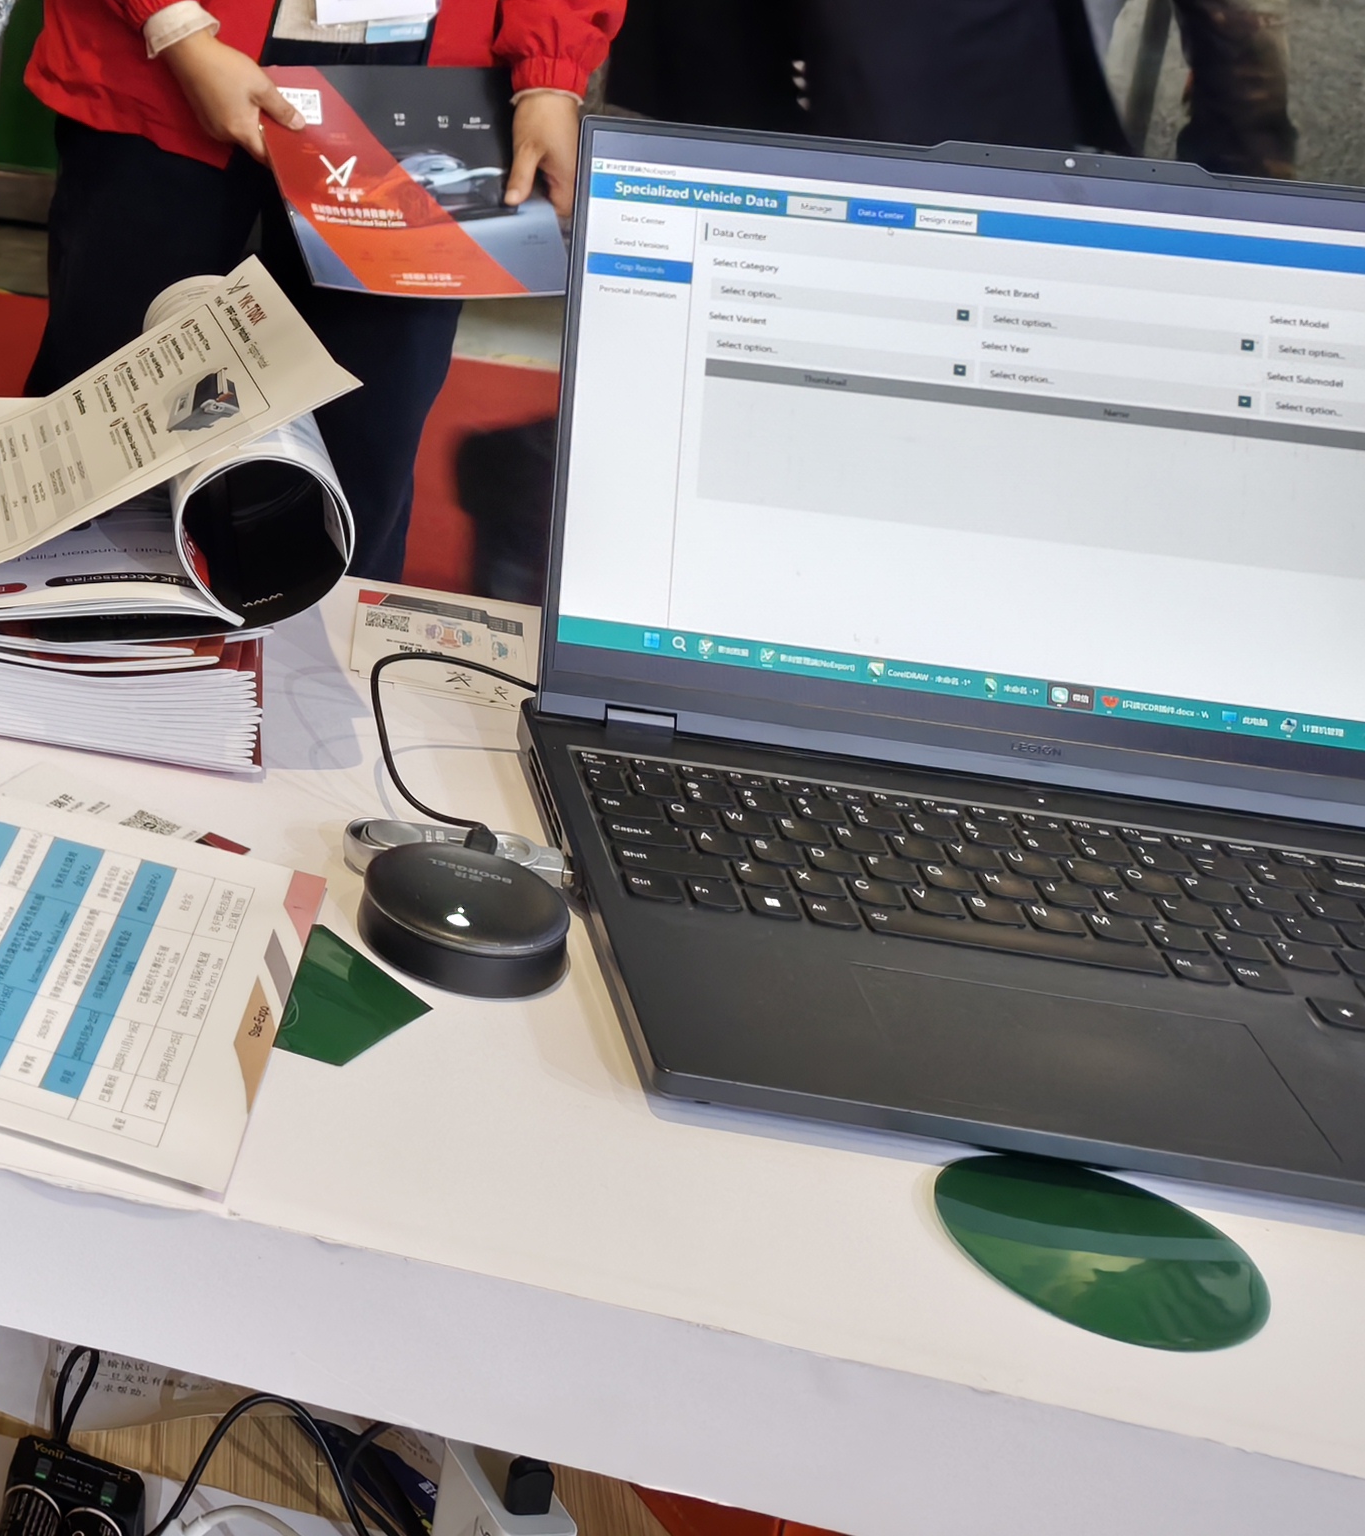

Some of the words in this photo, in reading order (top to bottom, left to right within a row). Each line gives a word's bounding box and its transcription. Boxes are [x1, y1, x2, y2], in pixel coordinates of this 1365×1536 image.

[614, 181, 689, 201] Specialized
[693, 189, 742, 206] Vehicle
[746, 194, 778, 210] Data
[801, 203, 833, 214] Manage
[621, 215, 640, 225] Data
[642, 217, 666, 227] Center
[858, 209, 876, 220] Data
[878, 210, 904, 222] Center
[919, 215, 946, 228] Design
[948, 218, 973, 229] center
[713, 227, 738, 240] Data
[740, 229, 767, 242] Center
[614, 238, 637, 249] Saved
[639, 240, 669, 251] Versions
[614, 263, 633, 275] Crop
[635, 264, 665, 275] Records
[713, 258, 738, 271] Select
[740, 260, 779, 275] Category
[599, 285, 633, 296] Personal
[635, 288, 677, 300] Information
[721, 286, 745, 296] Select
[985, 286, 1011, 298] Select
[1013, 289, 1040, 299] Brand
[709, 312, 734, 323] Select
[736, 314, 767, 325] Variant
[993, 315, 1019, 326] Select
[1269, 315, 1296, 326] Select
[1299, 318, 1330, 329] Model
[716, 340, 741, 350] Select
[981, 341, 1007, 352] Select
[1010, 343, 1030, 354] Year
[1278, 345, 1306, 356] Select
[989, 370, 1016, 381] Select
[1267, 372, 1294, 382] Select
[1296, 374, 1344, 388] Submodel
[1275, 401, 1303, 412] Select
[65, 573, 158, 586] Accessories
[888, 668, 929, 681] CorelDRAW
[1011, 742, 1061, 757] LEGION
[601, 797, 620, 806] Tab
[670, 804, 686, 813] Q
[726, 812, 744, 822] W
[781, 819, 795, 829] E
[838, 827, 852, 838] R
[893, 835, 906, 845] T
[949, 844, 963, 855] Y
[1008, 851, 1023, 863] U
[1067, 860, 1074, 869] I
[1126, 868, 1143, 880] O
[1185, 877, 1199, 888] P
[611, 823, 653, 836] CapsLk
[700, 831, 713, 842] A
[754, 840, 768, 850] S
[811, 848, 825, 857] D
[868, 856, 880, 865] F
[927, 865, 943, 876] G
[984, 874, 1000, 884] H
[1046, 882, 1056, 892] J
[1103, 891, 1120, 901] K
[1164, 900, 1177, 910] L
[622, 850, 648, 860] Shift
[739, 862, 753, 872] Z
[796, 870, 812, 881] X
[854, 880, 869, 890] C
[912, 888, 926, 899] V
[971, 897, 986, 908] B
[1031, 905, 1048, 917] N
[1092, 914, 1111, 925] M
[631, 876, 651, 886] Ctrl
[694, 885, 709, 894] Fn
[811, 903, 827, 912] Alt
[1237, 968, 1261, 977] Ctrl
[246, 1002, 271, 1040] Star-Expo
